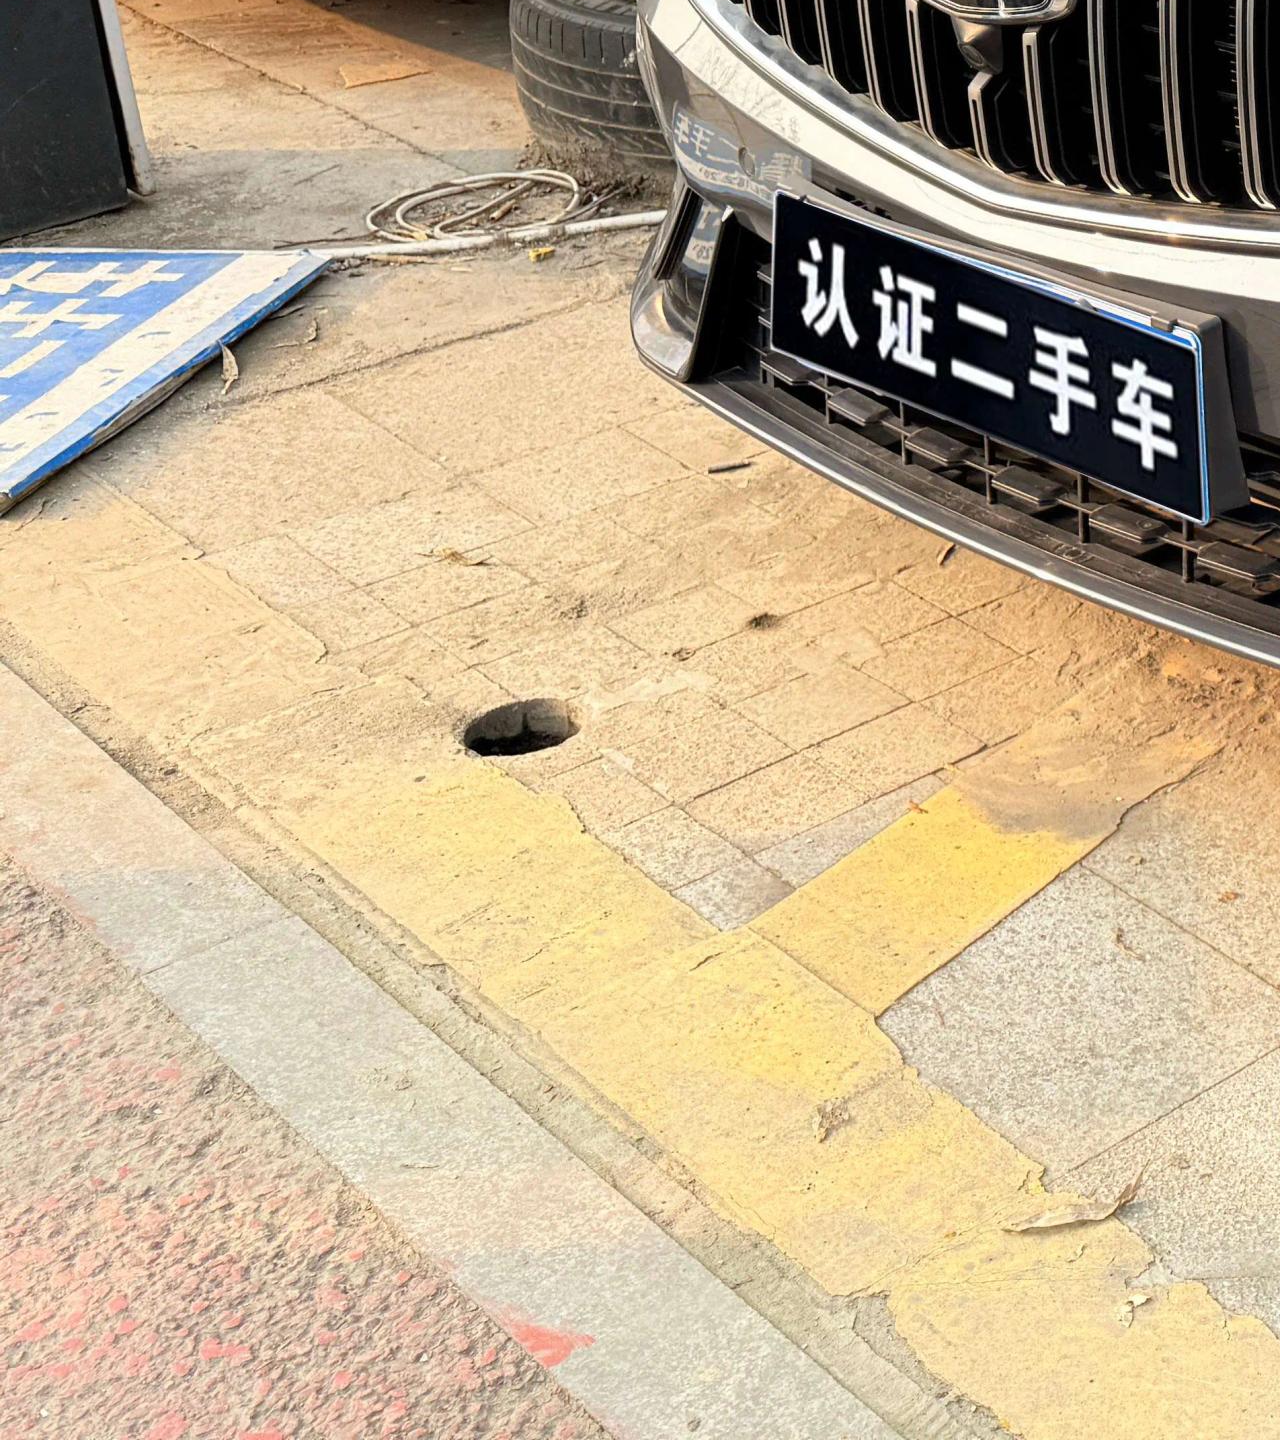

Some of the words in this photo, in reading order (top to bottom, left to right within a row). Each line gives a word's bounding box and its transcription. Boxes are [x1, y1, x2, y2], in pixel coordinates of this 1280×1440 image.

[798, 237, 1179, 472] 认证二手车
